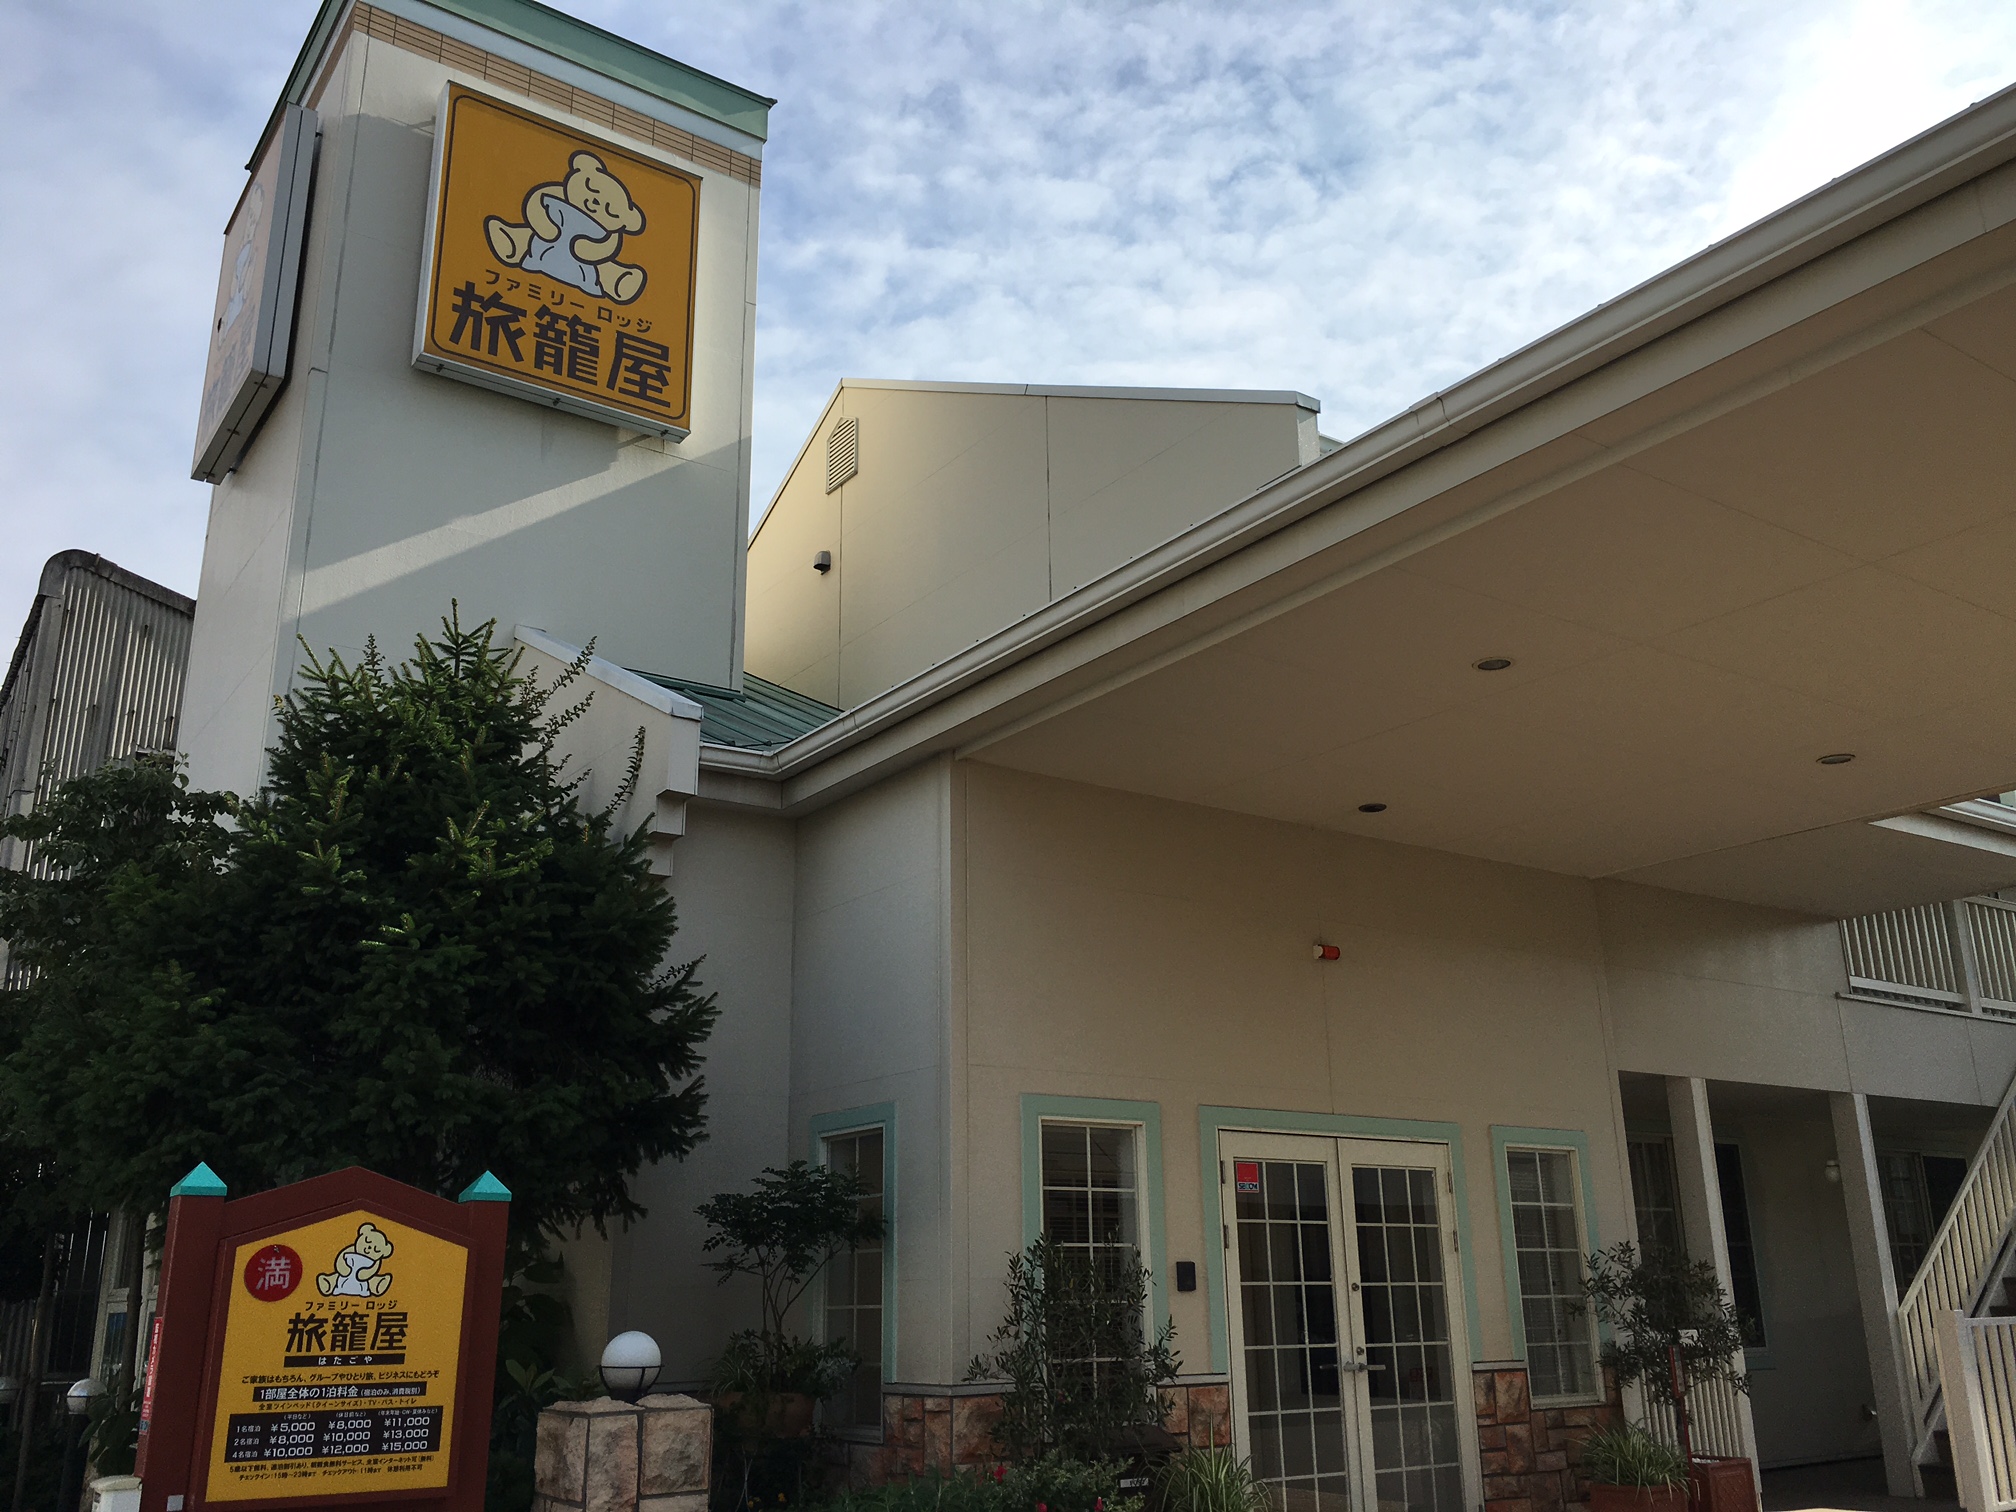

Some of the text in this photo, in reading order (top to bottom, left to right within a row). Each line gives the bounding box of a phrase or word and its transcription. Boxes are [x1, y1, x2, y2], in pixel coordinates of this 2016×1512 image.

[486, 269, 652, 334] ファミリー ロッジ
[449, 280, 672, 408] 旅籠屋
[255, 1255, 291, 1291] 満
[305, 1300, 397, 1311] ファミリー ロッジ
[285, 1311, 408, 1353] 旅籠屋
[318, 1356, 373, 1365] はたごや
[271, 1421, 316, 1433] ¥5,000
[328, 1419, 372, 1430] ¥8,000
[384, 1417, 430, 1428] ¥11,000
[269, 1434, 314, 1445] ¥8,000
[323, 1431, 371, 1442] ¥10,000
[382, 1428, 429, 1439] ¥13,000
[264, 1446, 313, 1458] ¥10,000
[321, 1443, 370, 1455] ¥12,000
[381, 1440, 428, 1452] ¥15,000
